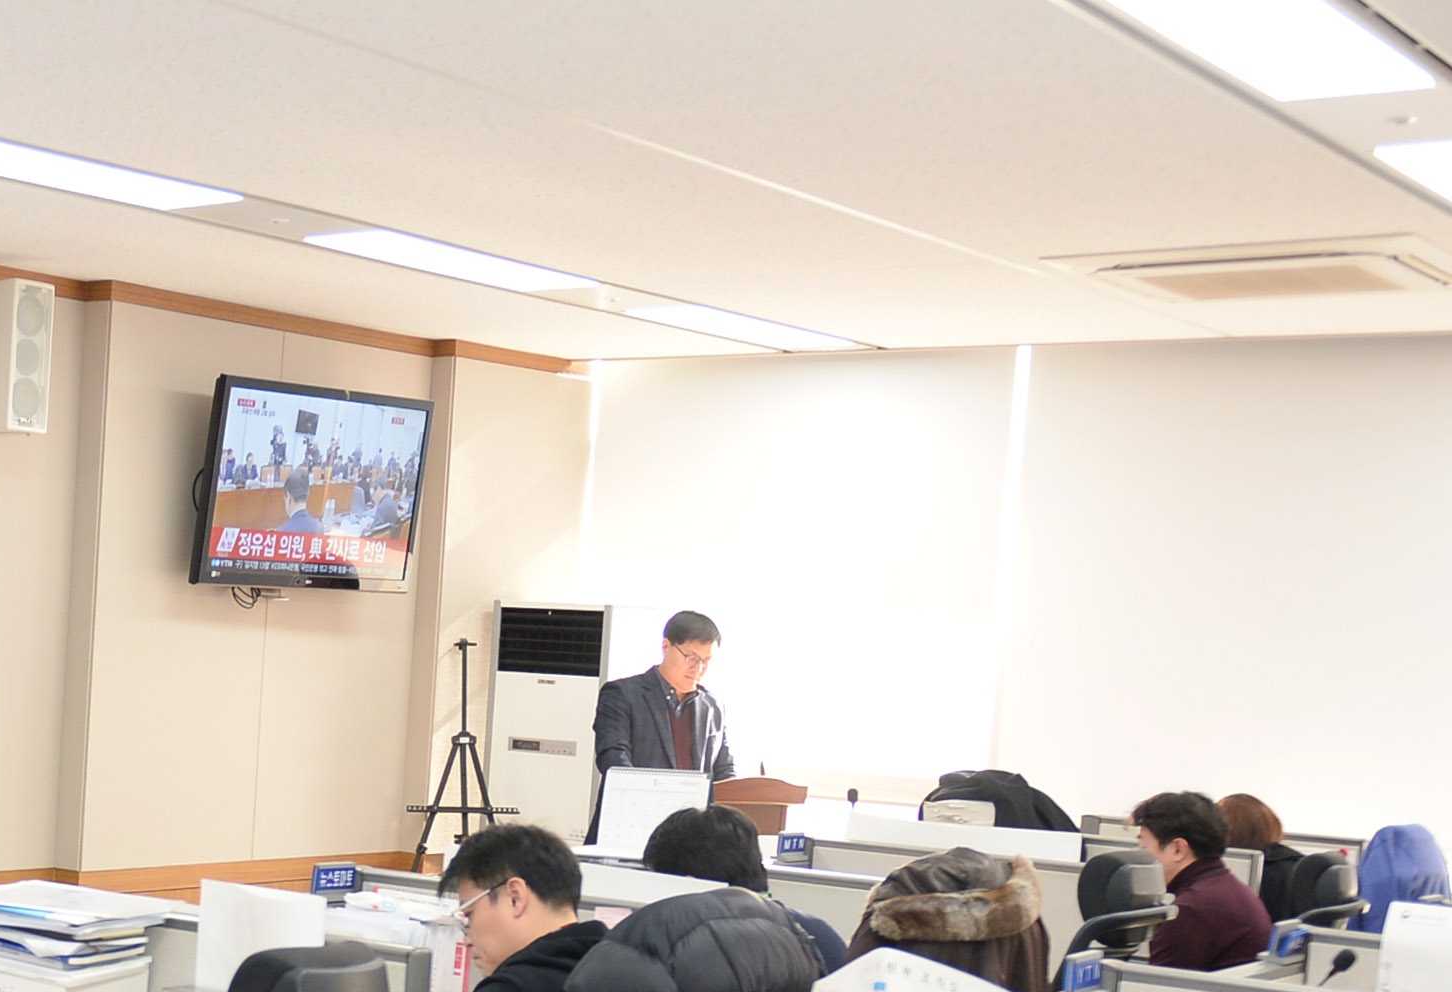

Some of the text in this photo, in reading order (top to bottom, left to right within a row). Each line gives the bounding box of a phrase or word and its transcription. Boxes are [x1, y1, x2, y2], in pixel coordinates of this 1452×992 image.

[238, 531, 277, 557] 정유섭
[325, 538, 361, 561] 간사로
[363, 540, 387, 563] 선임
